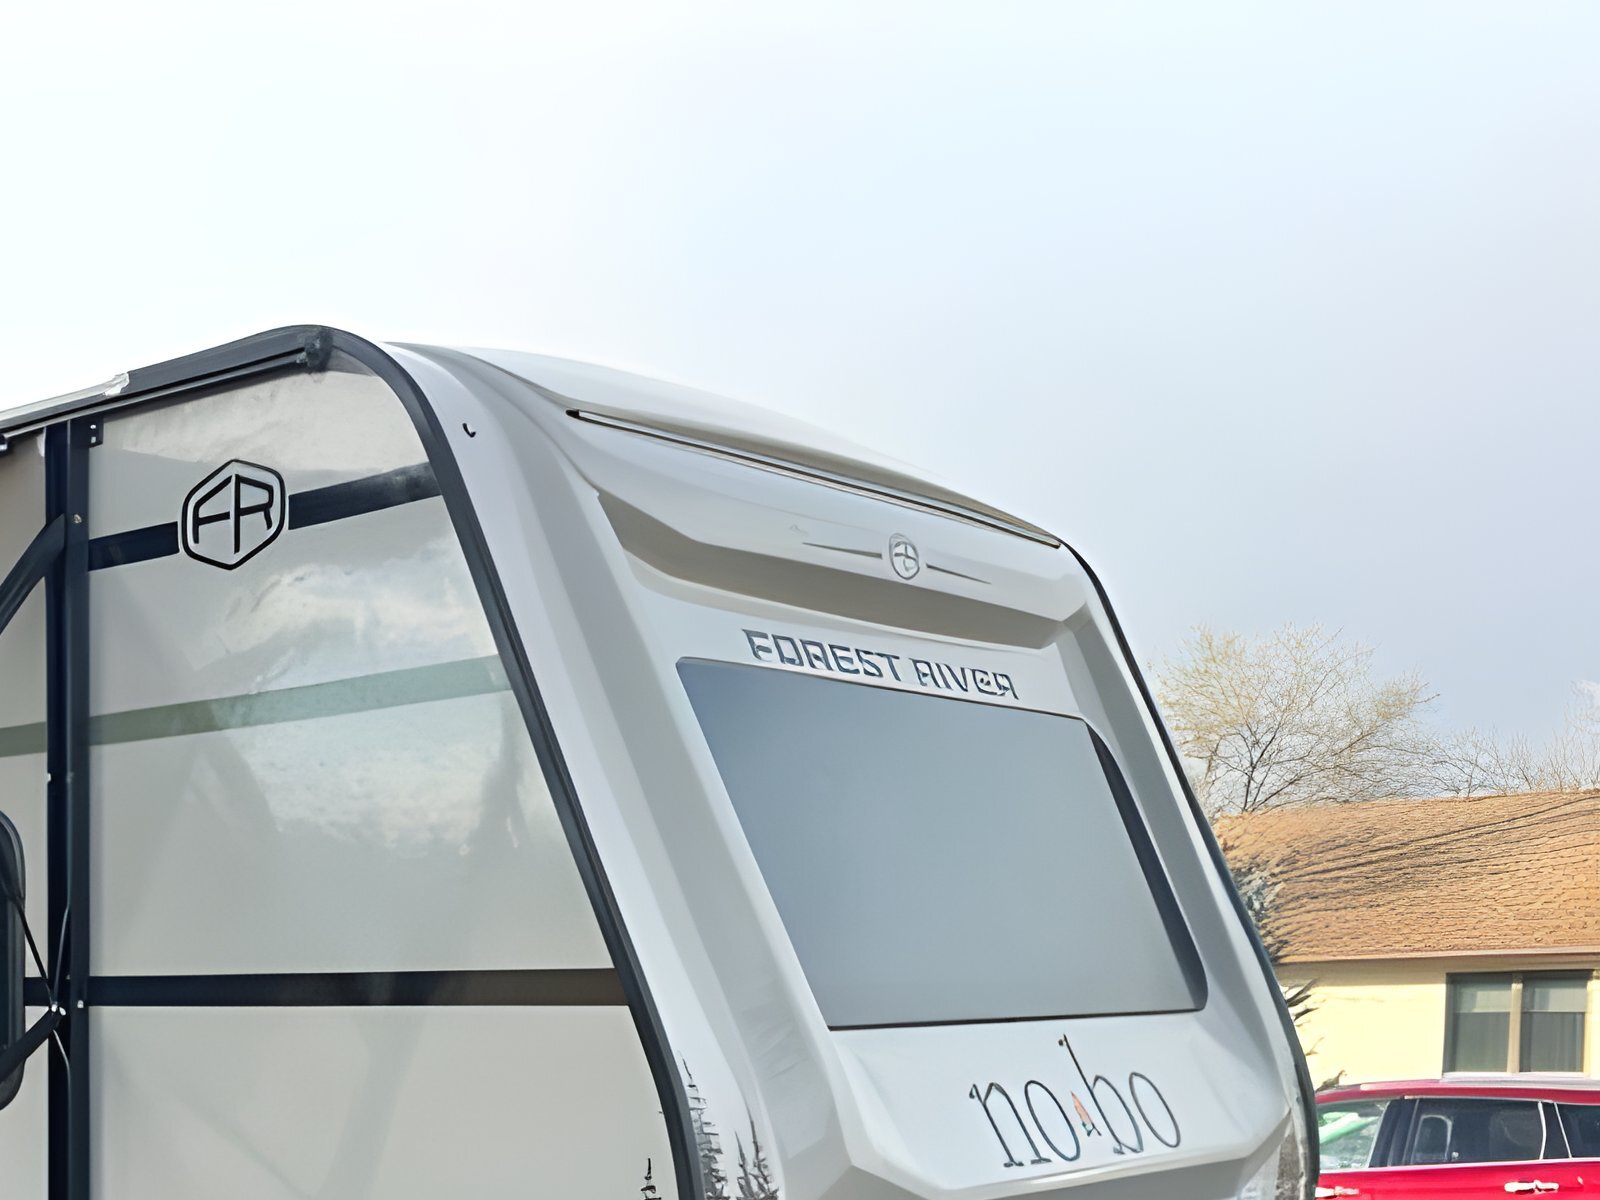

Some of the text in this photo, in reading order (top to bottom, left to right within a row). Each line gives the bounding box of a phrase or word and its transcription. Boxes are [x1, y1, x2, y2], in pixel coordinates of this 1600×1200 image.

[741, 628, 1020, 701] FOREST RIVER
[968, 1033, 1182, 1168] nobo
